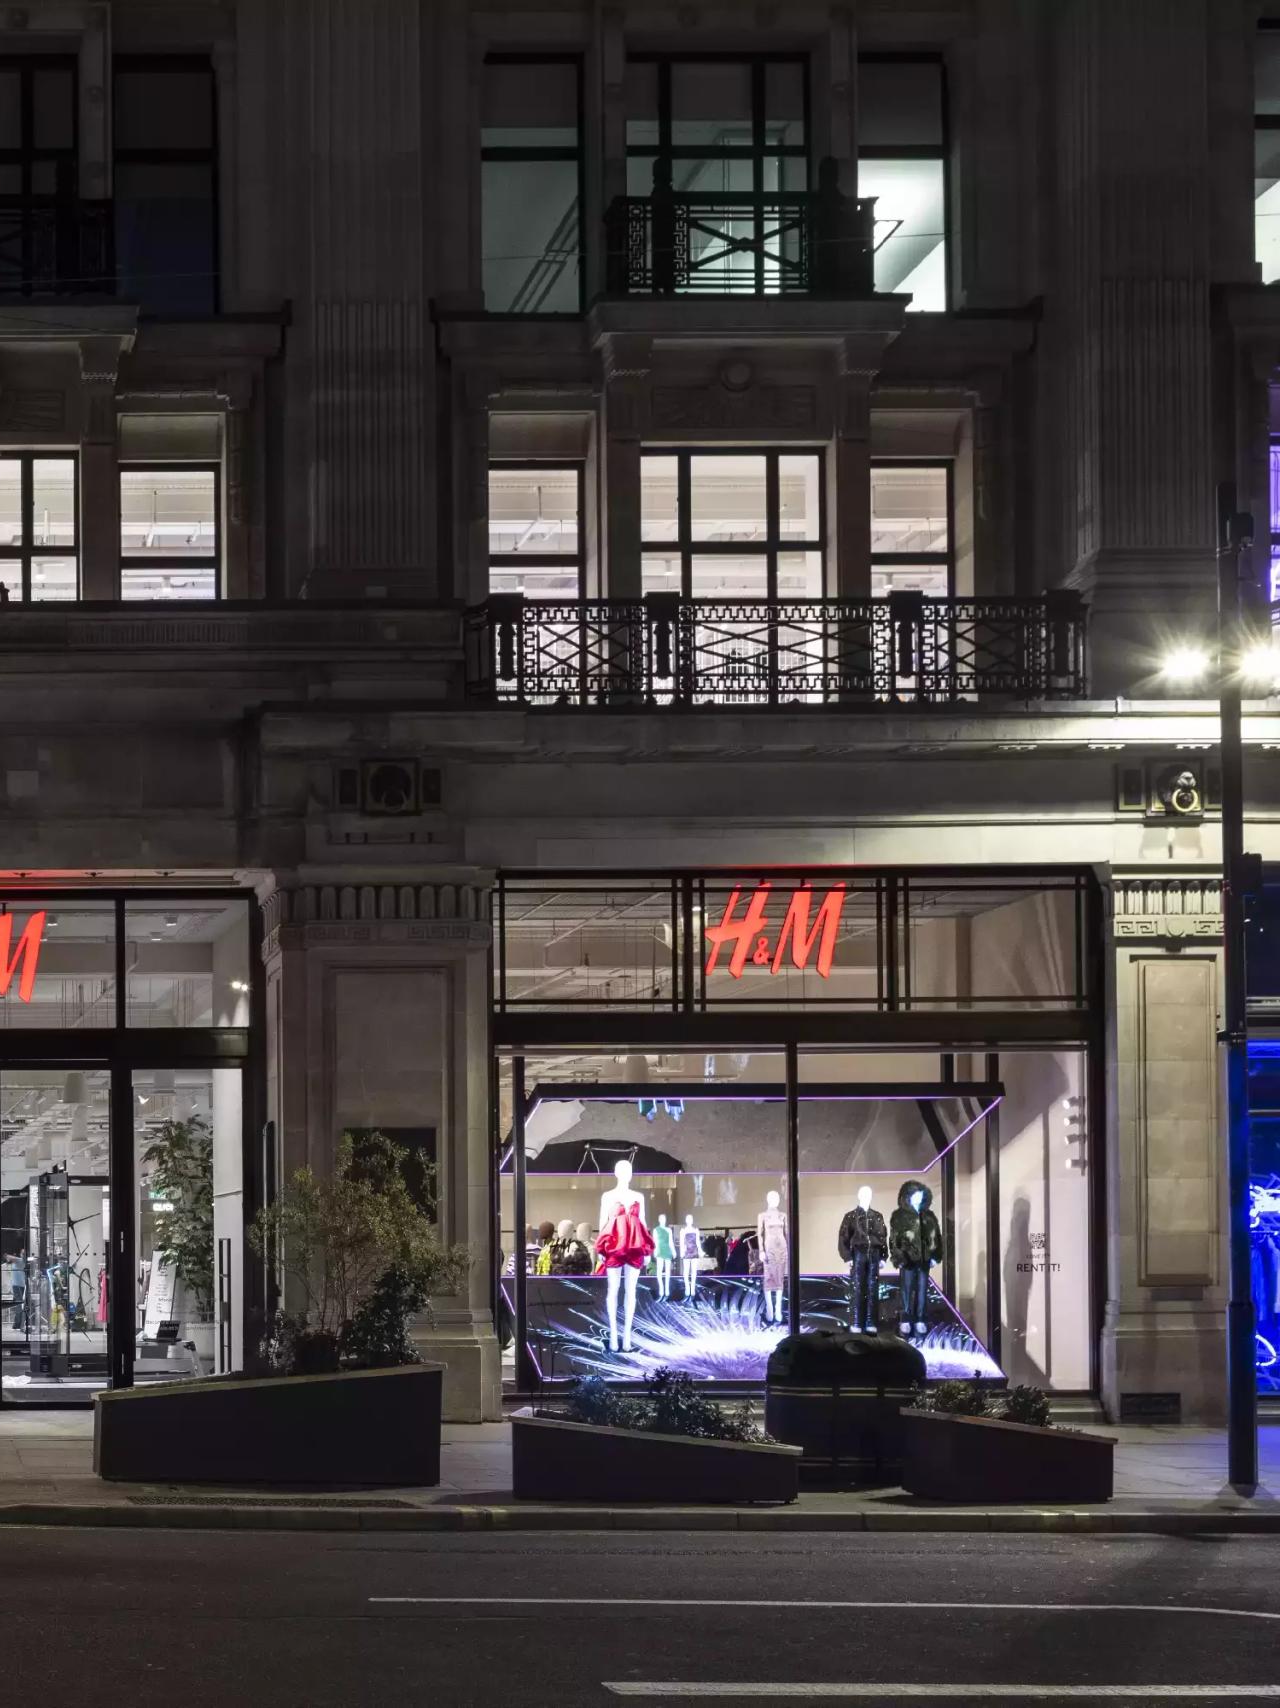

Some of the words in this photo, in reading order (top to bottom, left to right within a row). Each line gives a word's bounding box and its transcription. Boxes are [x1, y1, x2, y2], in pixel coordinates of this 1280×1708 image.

[705, 880, 847, 979] H&M
[1016, 1263, 1045, 1272] RENT
[1047, 1263, 1061, 1272] IT!
